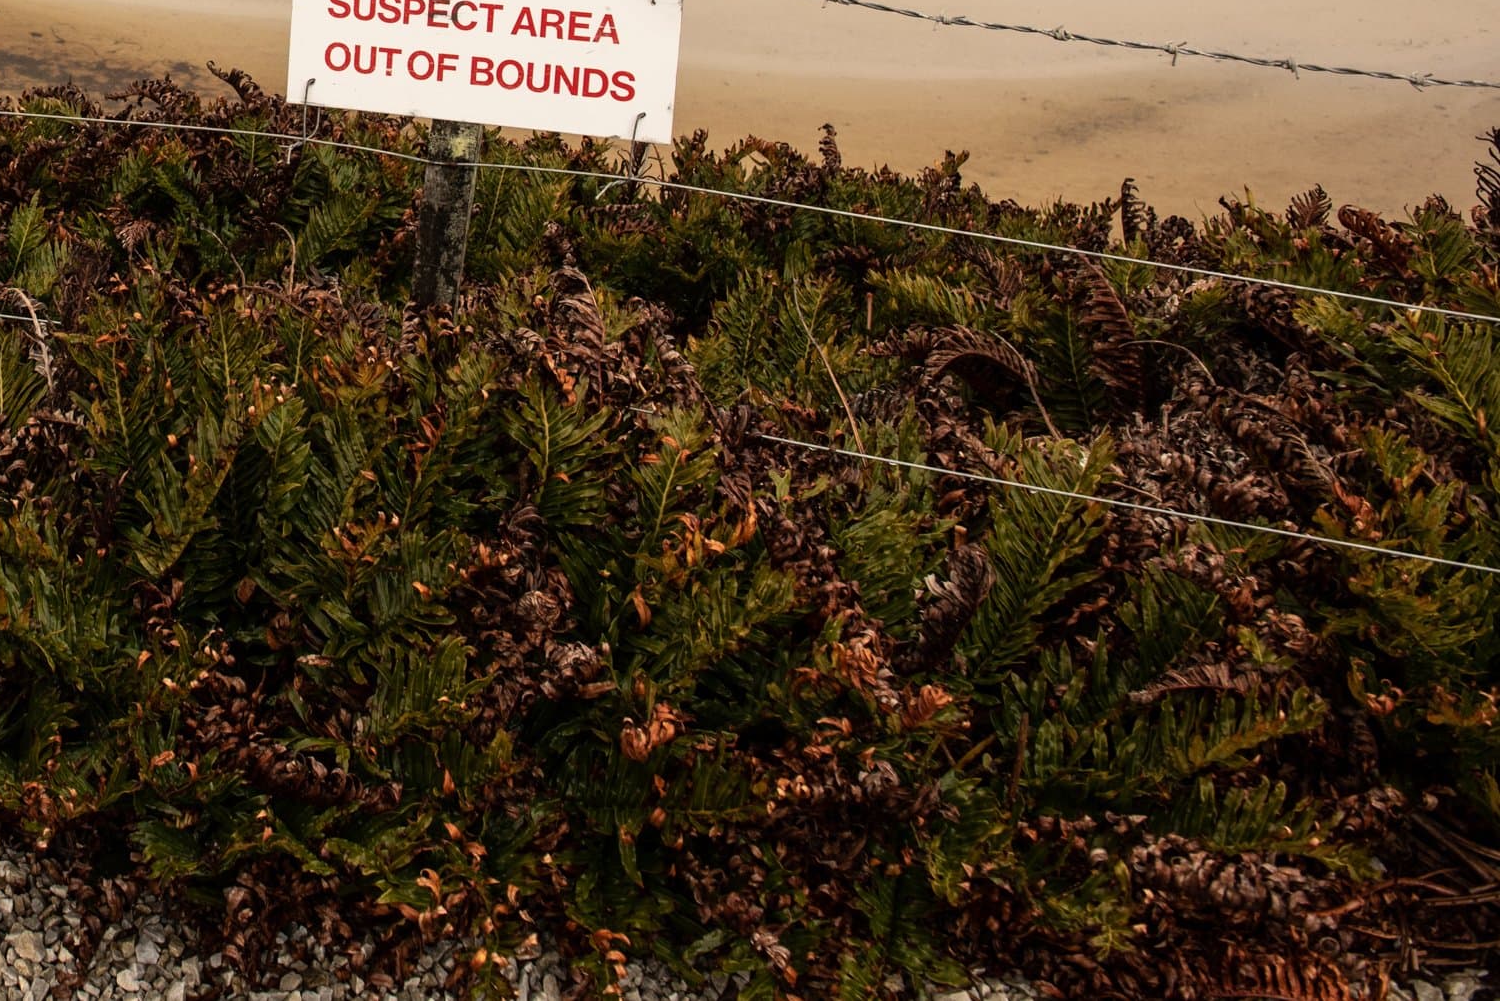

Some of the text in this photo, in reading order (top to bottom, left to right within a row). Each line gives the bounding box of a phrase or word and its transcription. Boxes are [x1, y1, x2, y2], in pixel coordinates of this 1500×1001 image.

[510, 6, 620, 45] AREA
[324, 42, 636, 102] OUT OF BOUNDS
